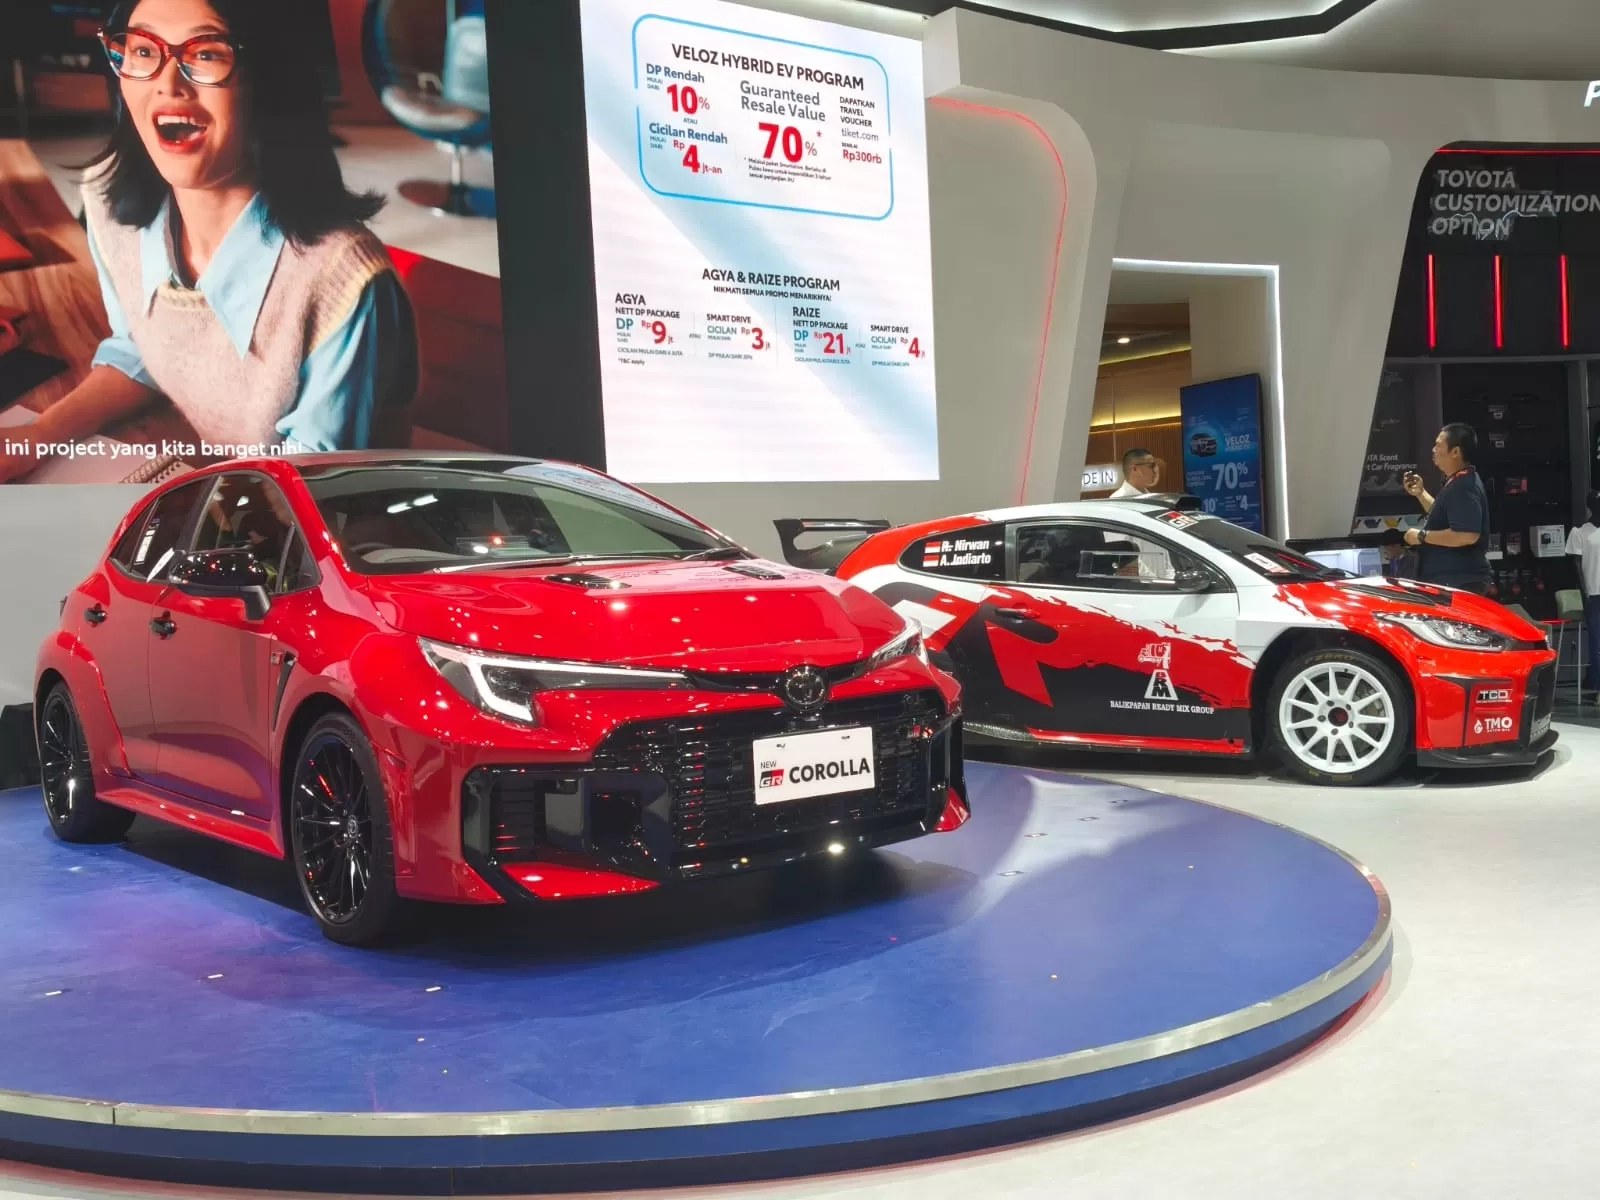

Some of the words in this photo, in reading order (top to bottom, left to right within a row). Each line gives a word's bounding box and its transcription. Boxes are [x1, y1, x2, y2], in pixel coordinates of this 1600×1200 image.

[646, 63, 662, 75] DP
[664, 66, 705, 83] Rendah
[671, 43, 719, 66] VELOZ
[721, 52, 774, 76] HYBRID
[776, 63, 794, 79] EV
[796, 66, 864, 91] PROGRAM
[740, 80, 820, 106] Guaranteed
[741, 95, 786, 116] Resale
[788, 104, 826, 122] Value
[839, 96, 876, 109] DAPATKAN
[840, 105, 864, 117] TRAVEL
[840, 115, 873, 128] VOUCHER
[649, 122, 686, 138] Cicilan
[687, 128, 728, 145] Rendah
[841, 127, 880, 142] tiket.com
[673, 139, 685, 151] Rp
[682, 145, 700, 174] 4
[843, 149, 882, 164] Rp300rb
[1437, 169, 1516, 189] TOYOTA
[1431, 217, 1511, 237] OPTION
[702, 268, 735, 283] AGYA
[737, 271, 746, 284] &
[748, 272, 781, 287] RAIZE
[783, 275, 840, 291] PROGRAM
[713, 285, 741, 295] NIKMATI
[742, 287, 764, 297] SEMUA
[765, 289, 788, 298] PROMO
[615, 293, 646, 306] AGYA
[615, 307, 634, 316] NETT
[635, 309, 645, 317] DP
[646, 309, 680, 319] PACKAGE
[706, 313, 731, 323] SMART
[731, 315, 752, 324] DRIVE
[793, 306, 821, 319] RAIZE
[616, 318, 634, 331] DP
[707, 325, 737, 335] CICILAN
[793, 319, 809, 328] NETT
[810, 320, 819, 329] DP
[820, 321, 848, 330] PACKAGE
[870, 324, 891, 333] SMART
[891, 325, 910, 334] DRIVE
[794, 329, 809, 341] DP
[871, 335, 897, 345] CICILAN
[1224, 434, 1251, 447] VELOZ
[5, 439, 29, 455] ini
[36, 440, 105, 459] project
[110, 443, 157, 459] yang
[163, 440, 196, 456] kita
[201, 440, 266, 459] banget
[1379, 453, 1398, 461] Scent
[1102, 471, 1114, 484] IN
[955, 540, 990, 552] Nirwan
[1110, 700, 1151, 710] BALIKPAPAN
[1152, 702, 1175, 712] READY
[1176, 704, 1190, 713] MIX
[1190, 705, 1215, 715] GROUP
[1484, 717, 1513, 729] TMO
[760, 760, 777, 769] NEW
[760, 772, 784, 788] GR
[788, 758, 871, 784] COROLLA
